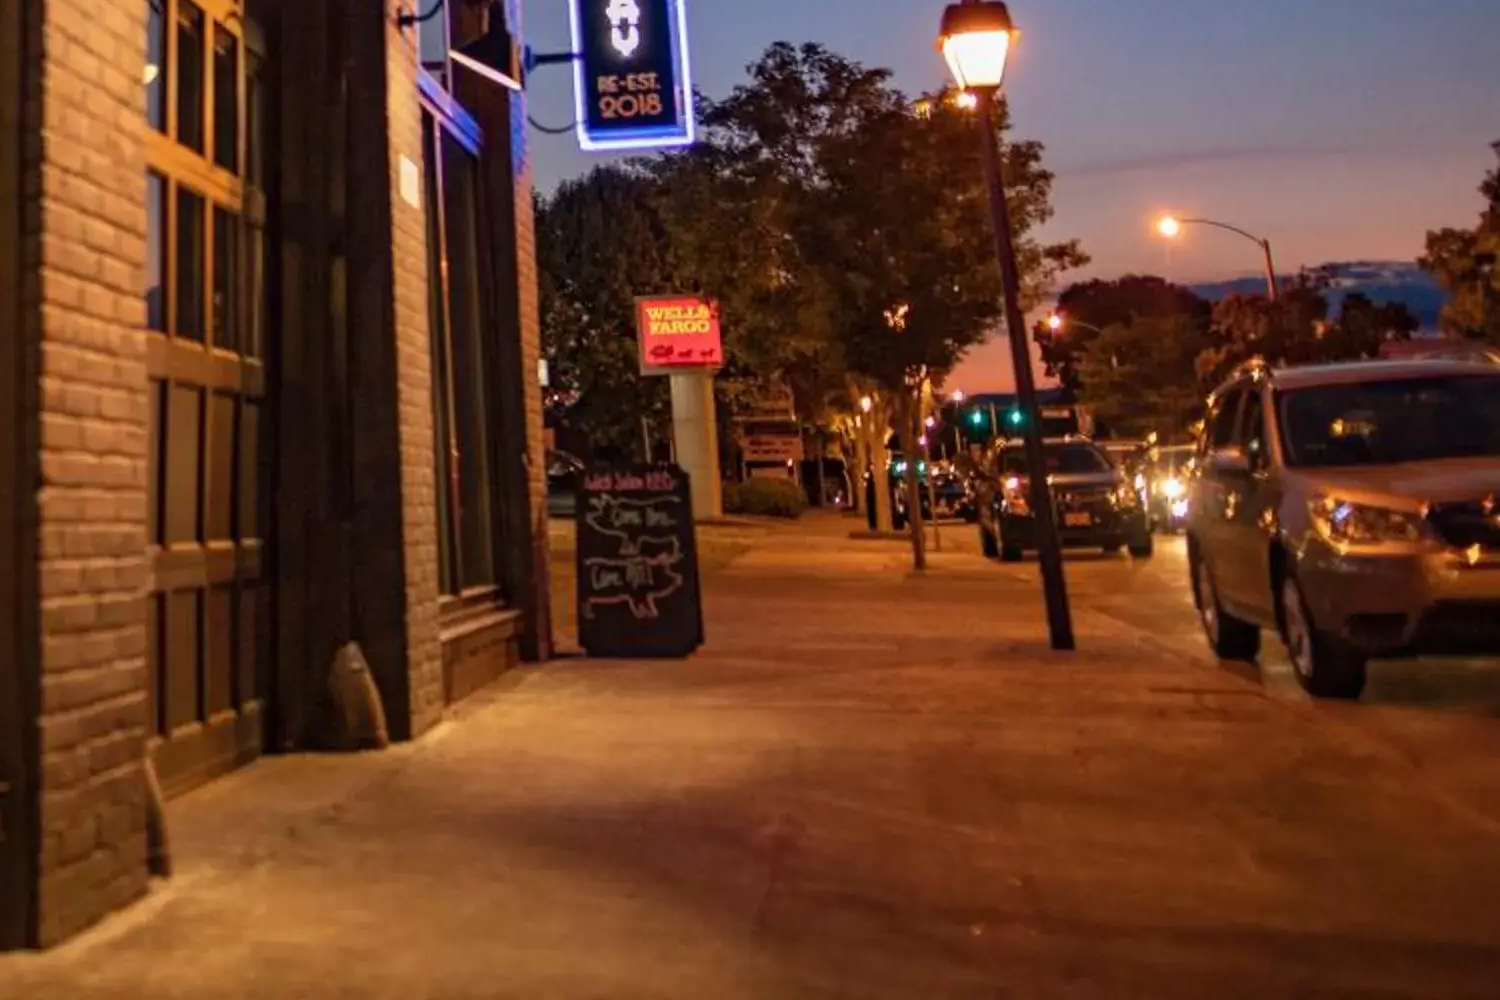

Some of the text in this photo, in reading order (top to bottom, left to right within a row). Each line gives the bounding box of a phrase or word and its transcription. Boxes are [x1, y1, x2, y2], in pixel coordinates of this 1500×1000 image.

[599, 93, 663, 118] 2018
[645, 304, 709, 319] WELLS
[648, 320, 710, 336] FARGO
